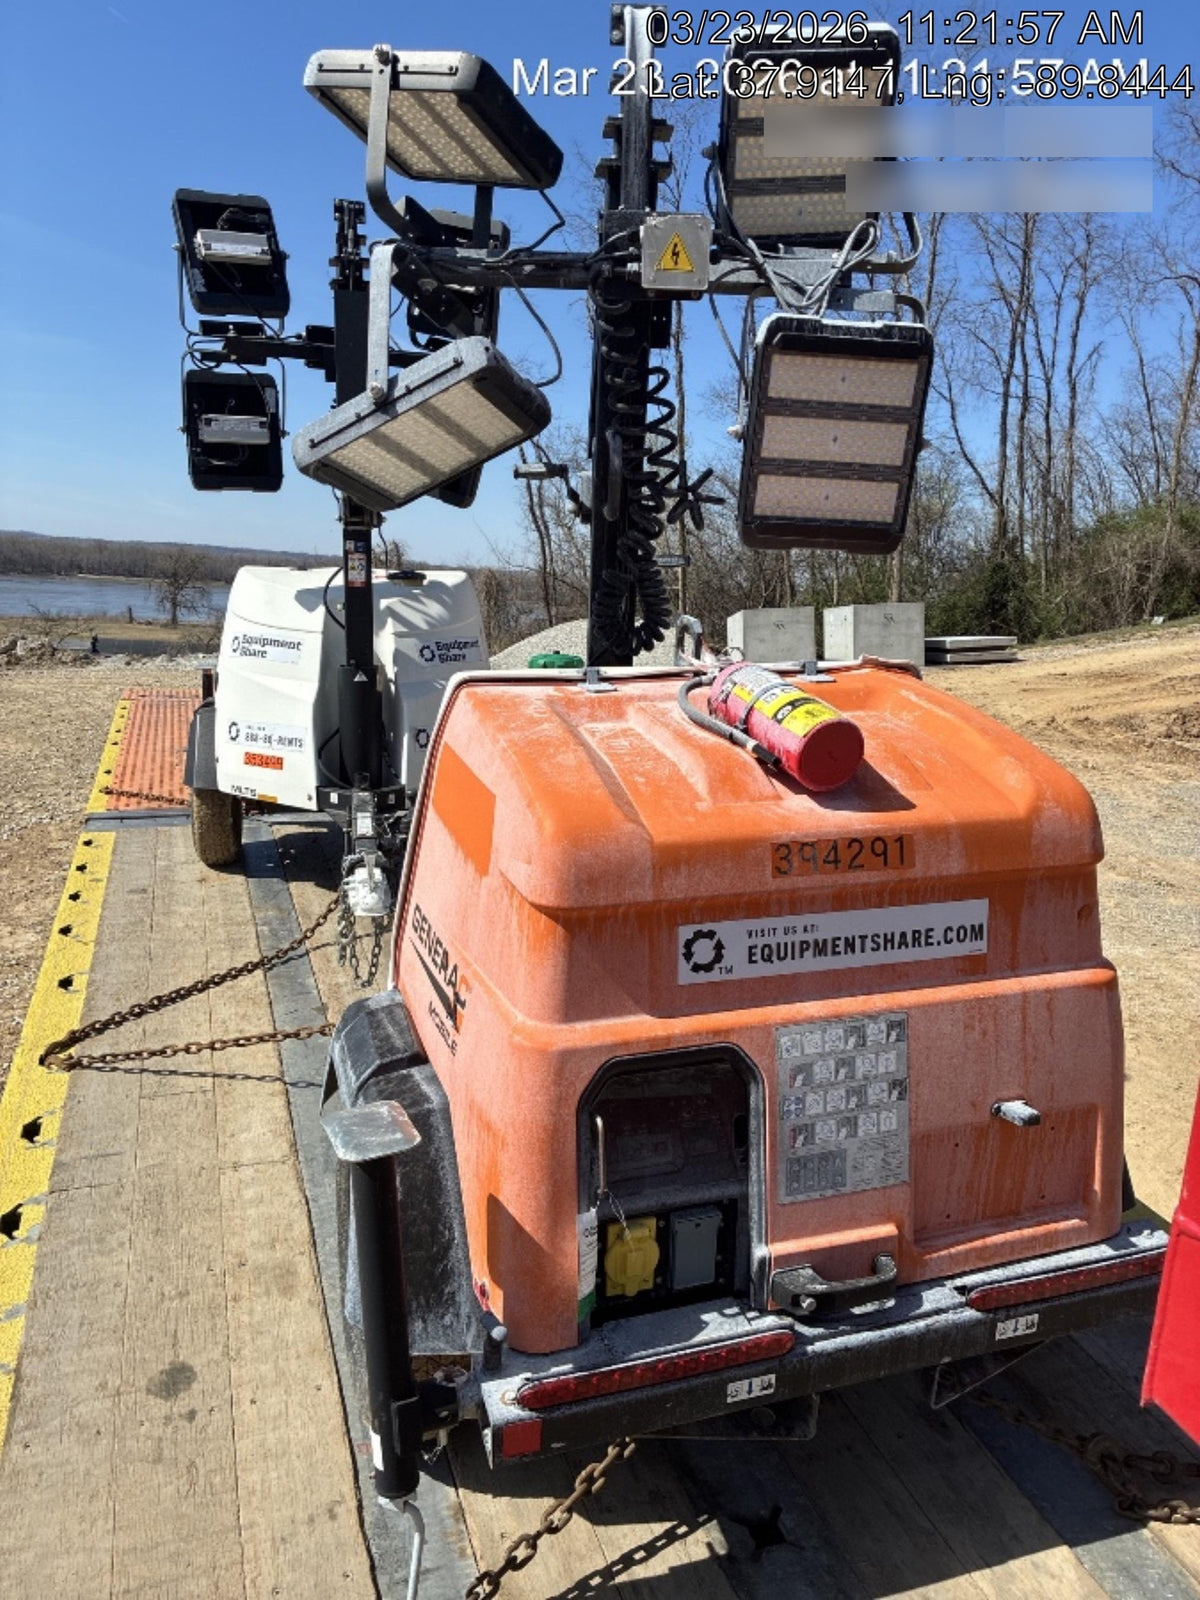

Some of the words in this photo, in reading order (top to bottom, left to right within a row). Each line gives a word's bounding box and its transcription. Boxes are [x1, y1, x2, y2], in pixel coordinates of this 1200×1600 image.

[774, 835, 907, 876] 394291
[746, 926, 778, 939] VISIT
[783, 925, 798, 936] US
[747, 922, 985, 965] EQUIPMENTSHARE.COM
